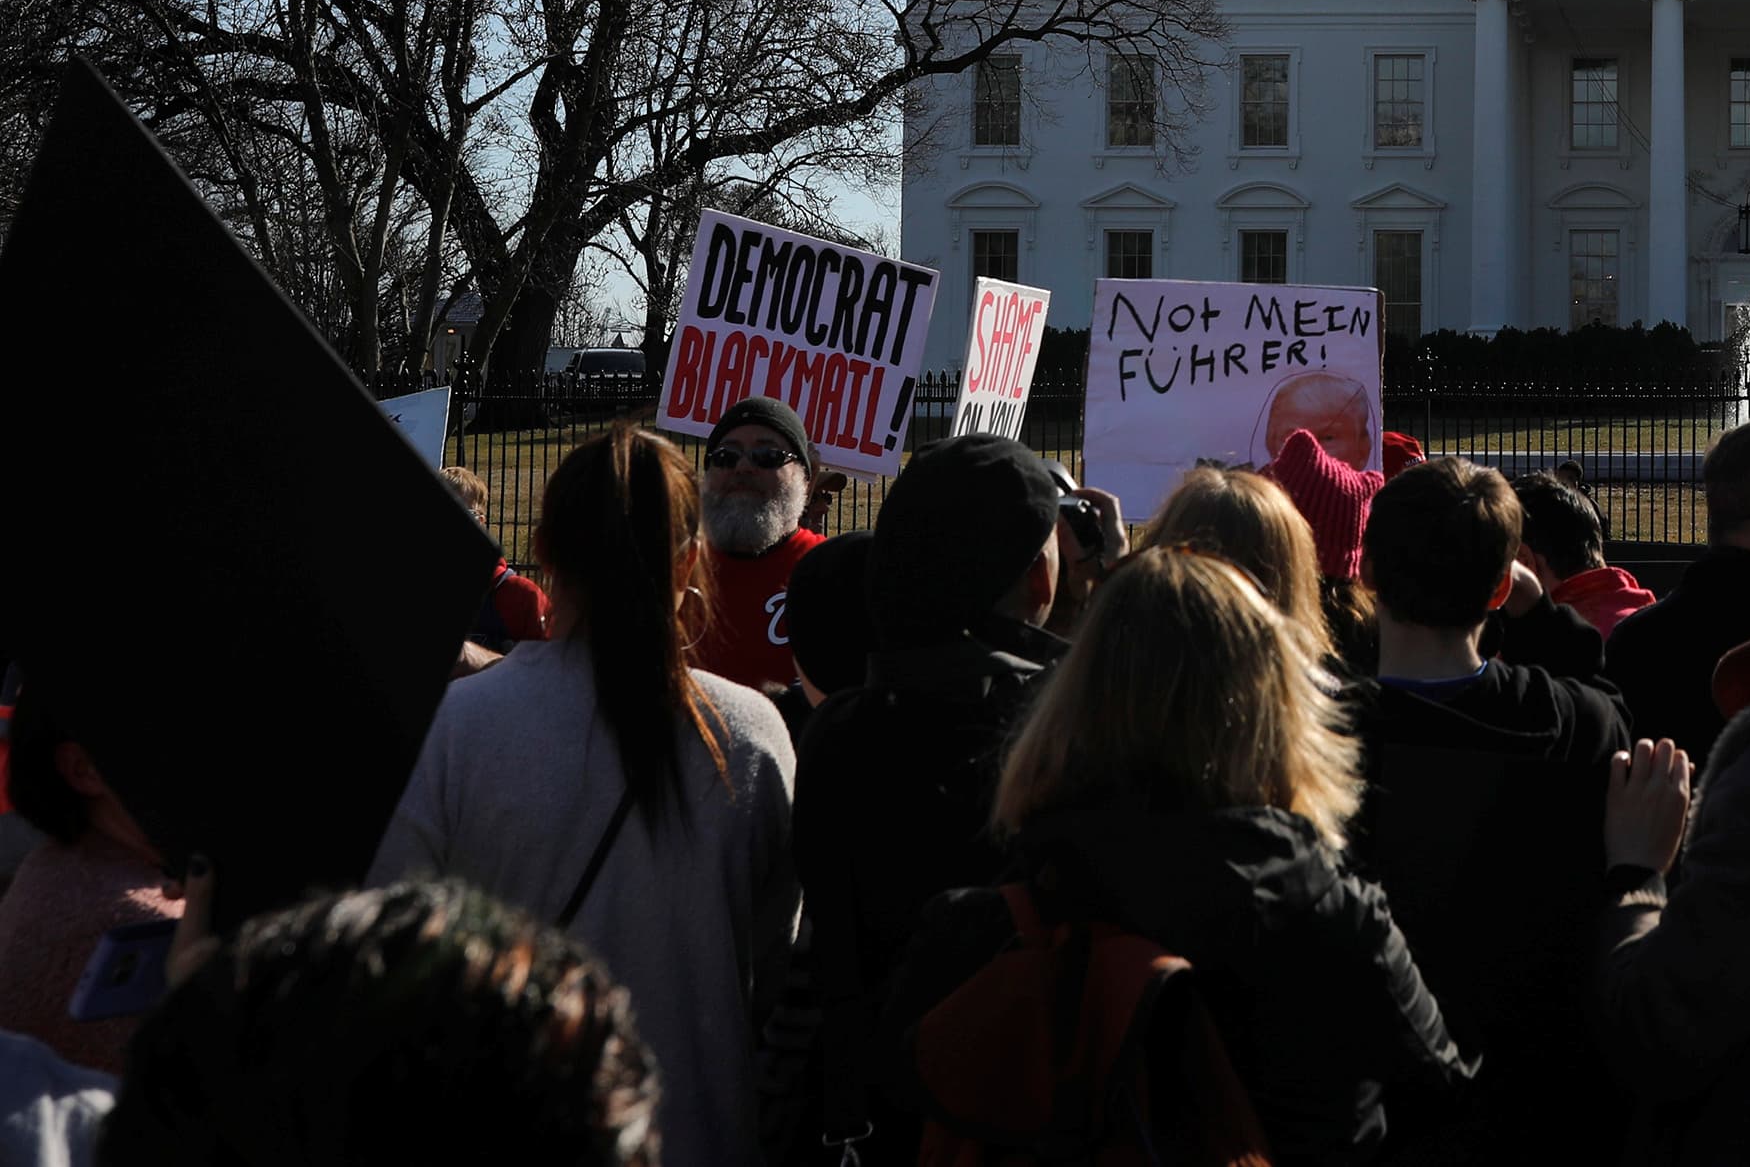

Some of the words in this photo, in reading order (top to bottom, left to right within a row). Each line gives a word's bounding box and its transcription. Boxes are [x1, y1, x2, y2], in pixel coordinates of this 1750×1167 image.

[697, 223, 933, 367] DEMOCRAT
[1244, 294, 1371, 337] MEIN
[968, 290, 1043, 400] SHAME
[1118, 339, 1328, 402] FÜHRER!
